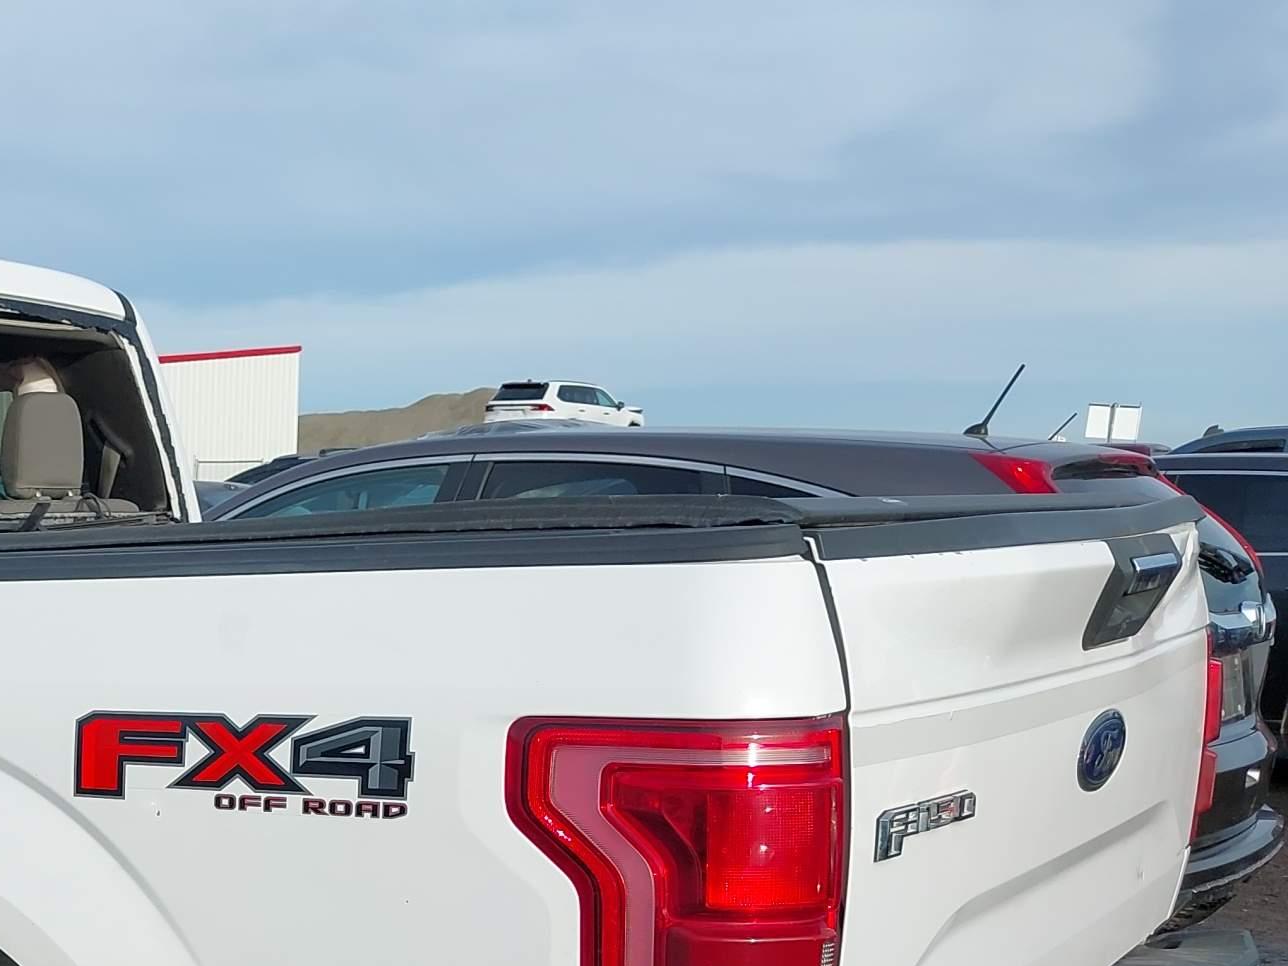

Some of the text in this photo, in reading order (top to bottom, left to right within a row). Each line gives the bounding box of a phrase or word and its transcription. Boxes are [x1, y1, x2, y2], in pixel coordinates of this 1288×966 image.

[73, 710, 416, 801] FX4
[214, 793, 409, 820] OFF ROAD
